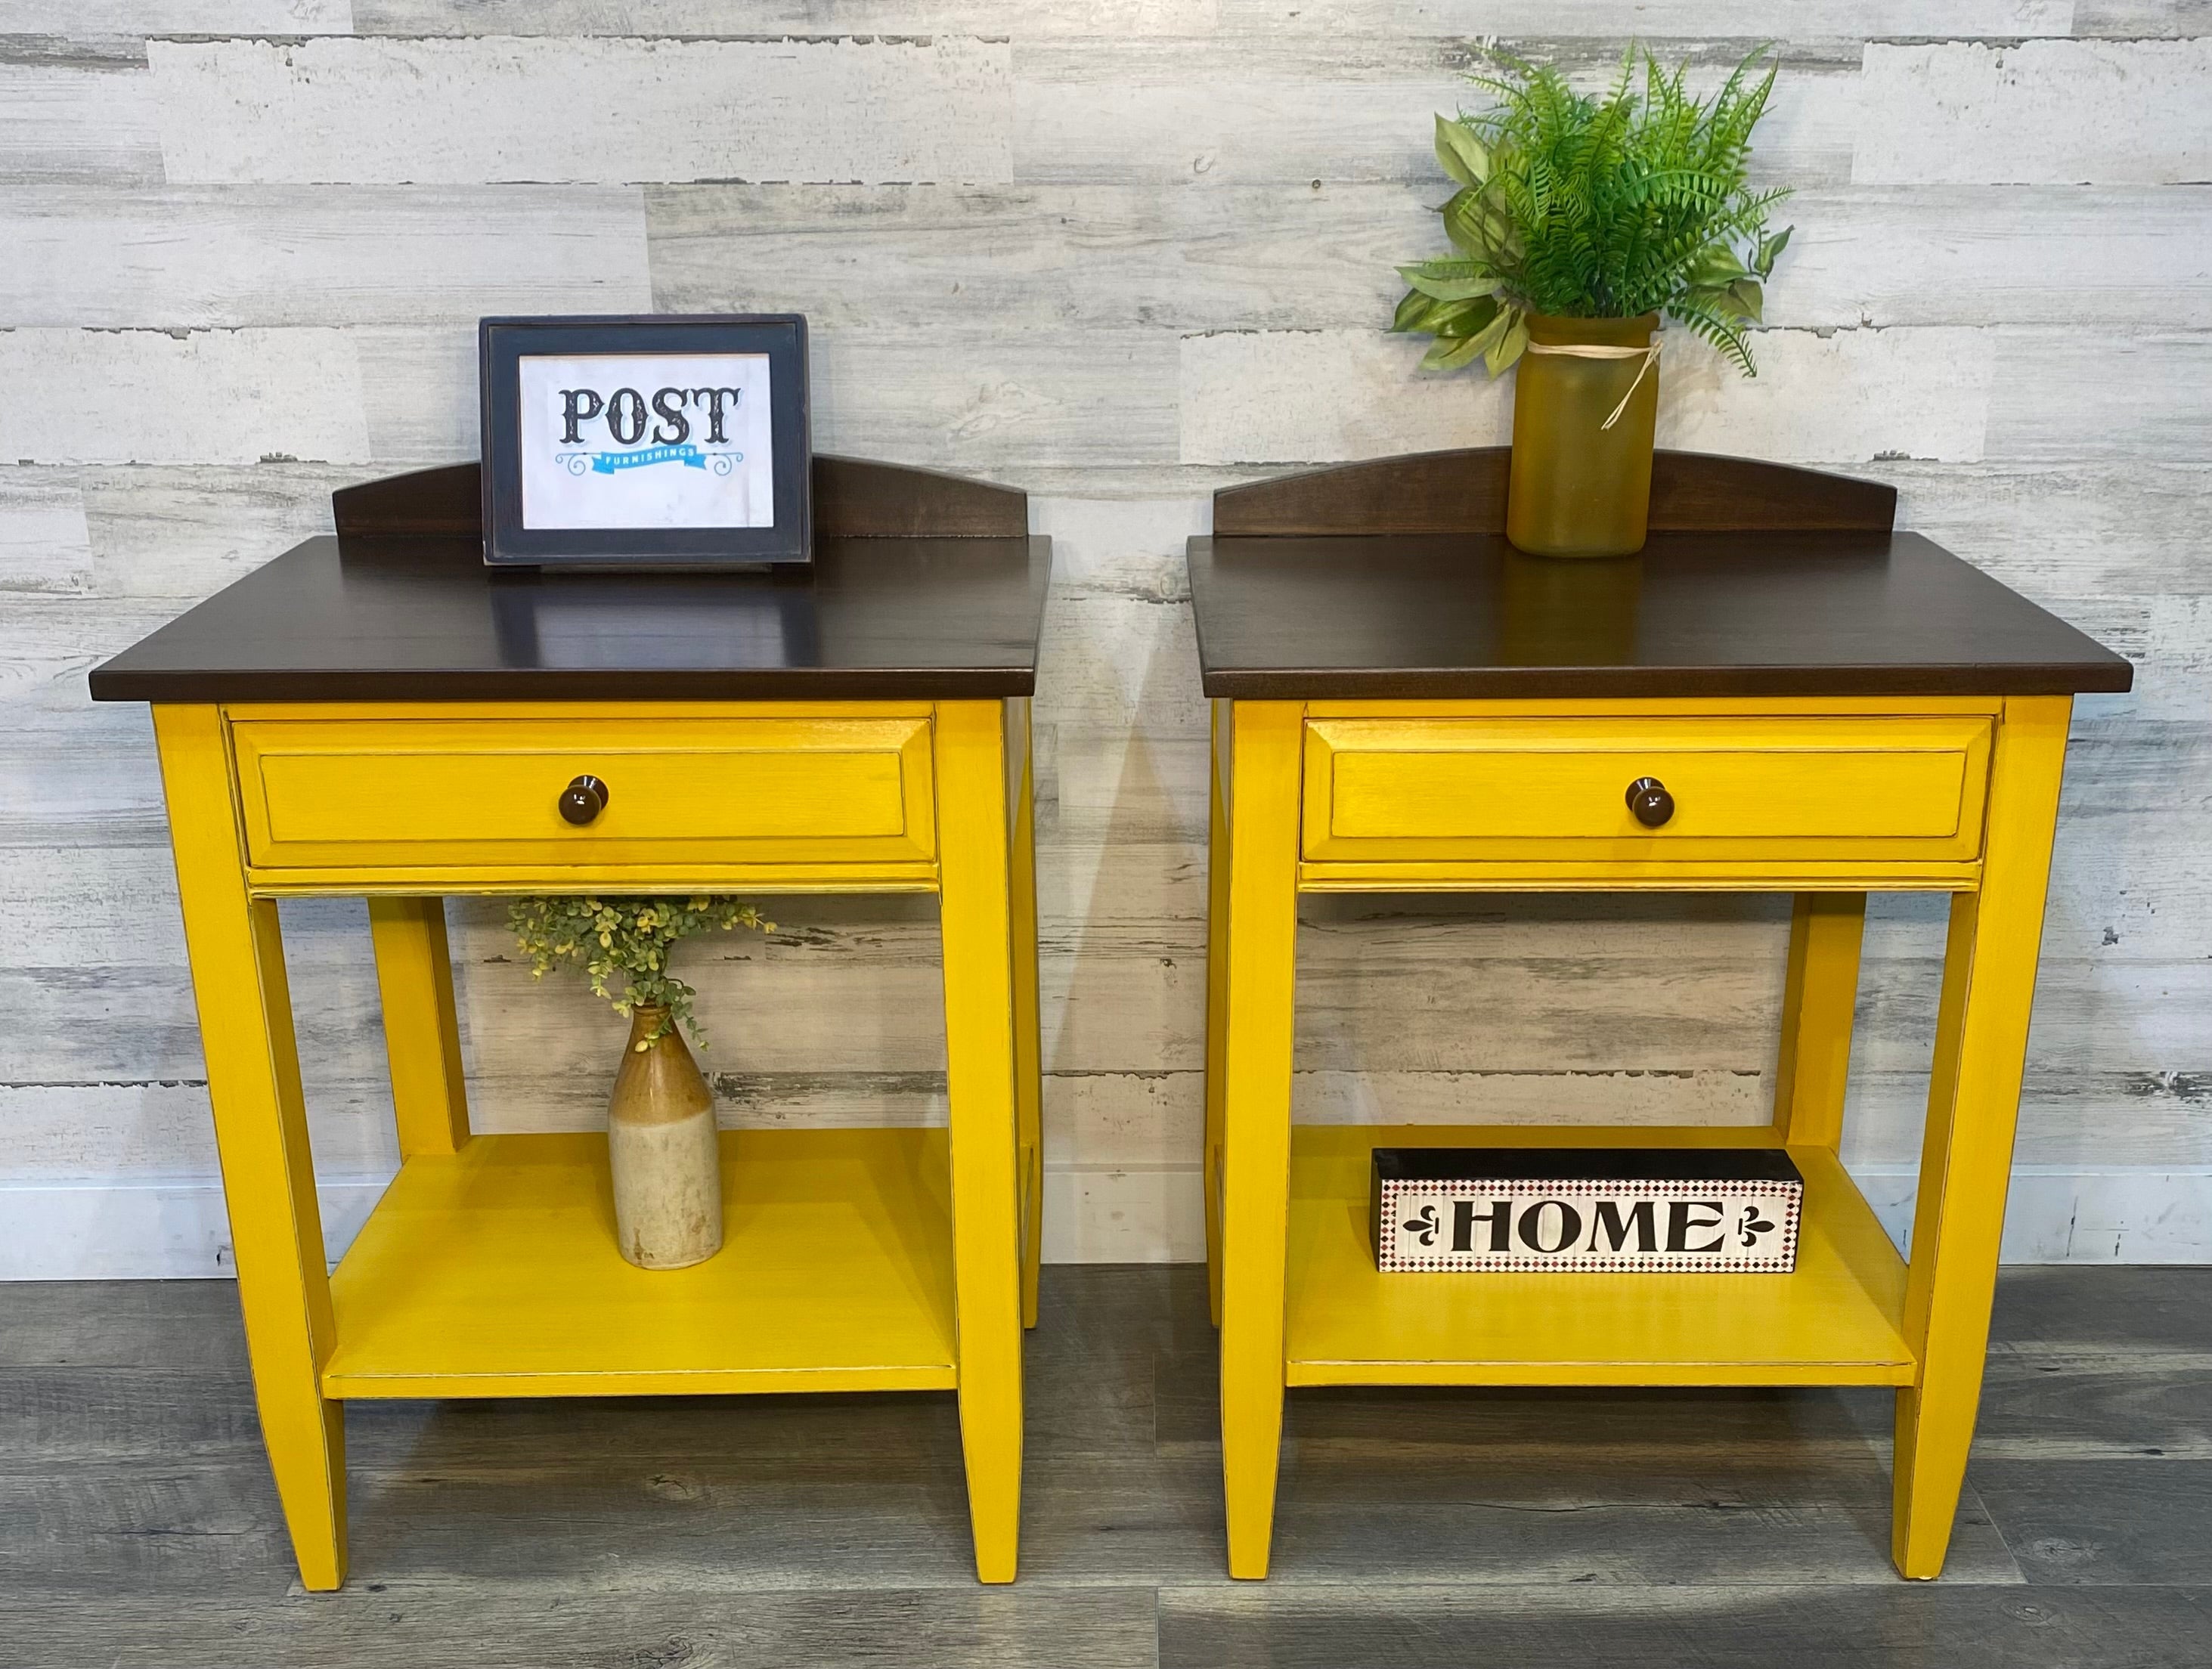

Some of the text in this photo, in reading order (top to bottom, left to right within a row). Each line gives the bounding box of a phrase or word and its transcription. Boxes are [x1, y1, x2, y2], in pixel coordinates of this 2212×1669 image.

[558, 387, 742, 444] POST
[606, 447, 696, 466] FURNISHINGS
[1451, 1200, 1726, 1253] HOME
